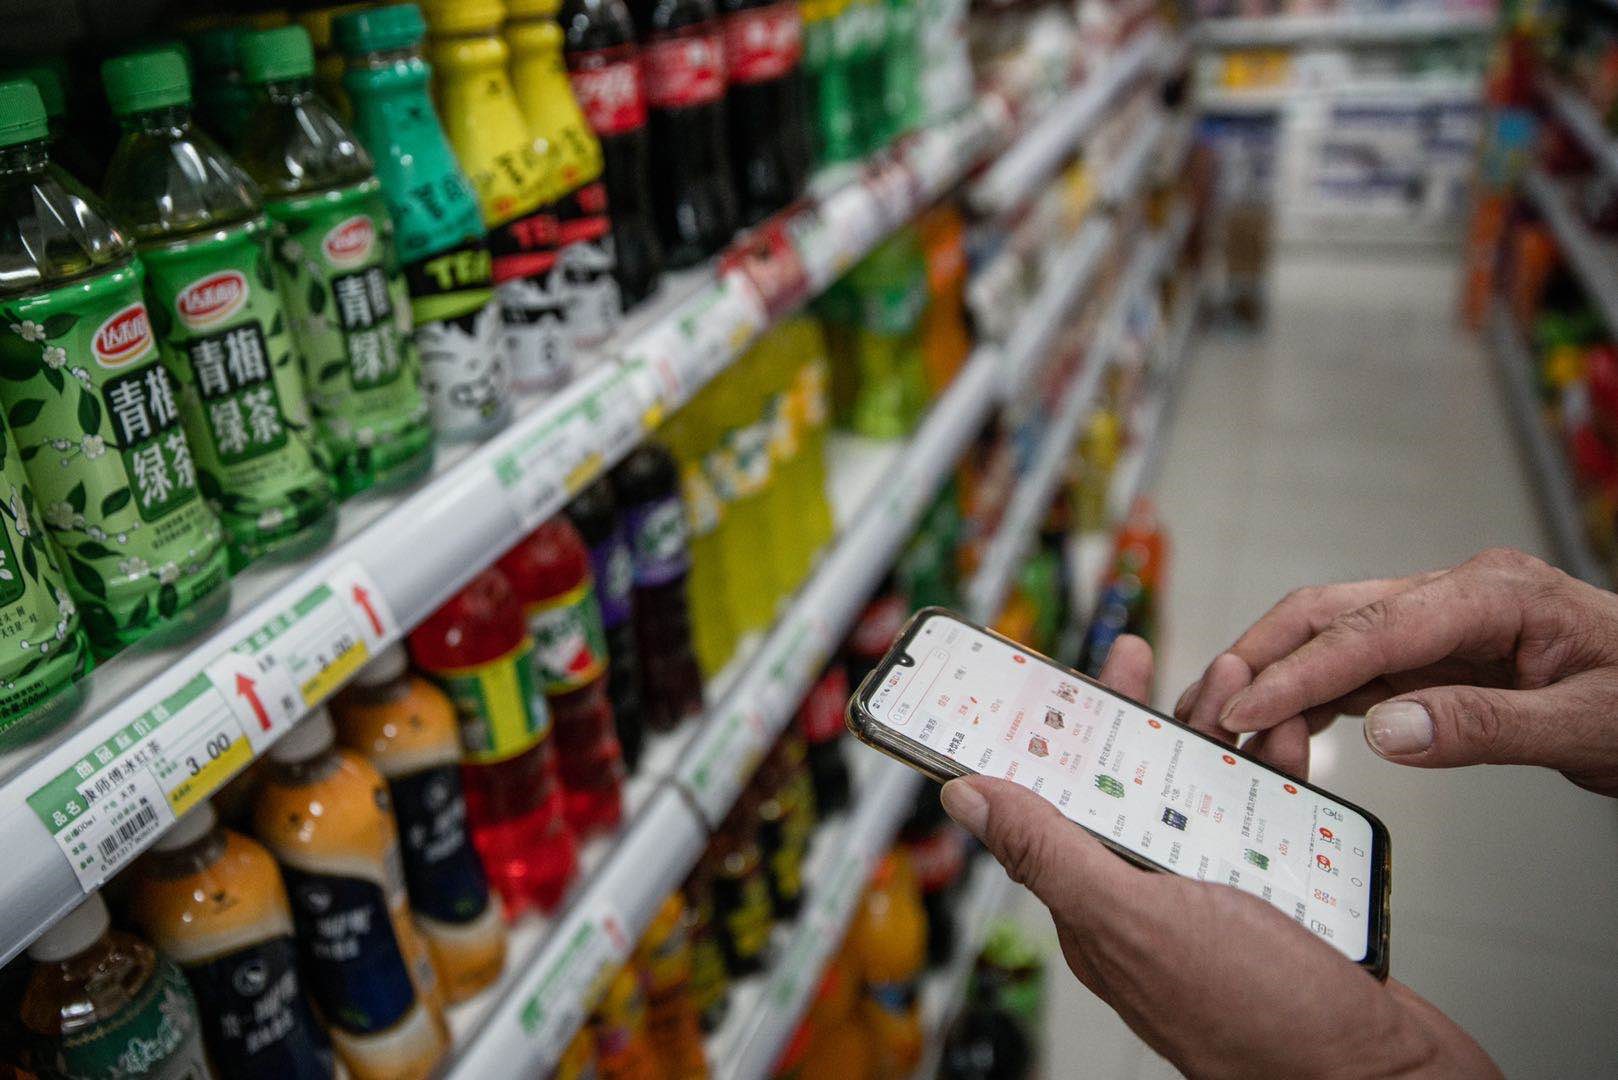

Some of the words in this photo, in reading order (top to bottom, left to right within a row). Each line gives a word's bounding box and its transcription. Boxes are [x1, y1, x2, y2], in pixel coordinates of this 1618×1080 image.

[190, 328, 267, 400] 青梅
[210, 387, 283, 454] 绿茶
[185, 731, 231, 777] 3.00
[52, 800, 81, 827] 品名
